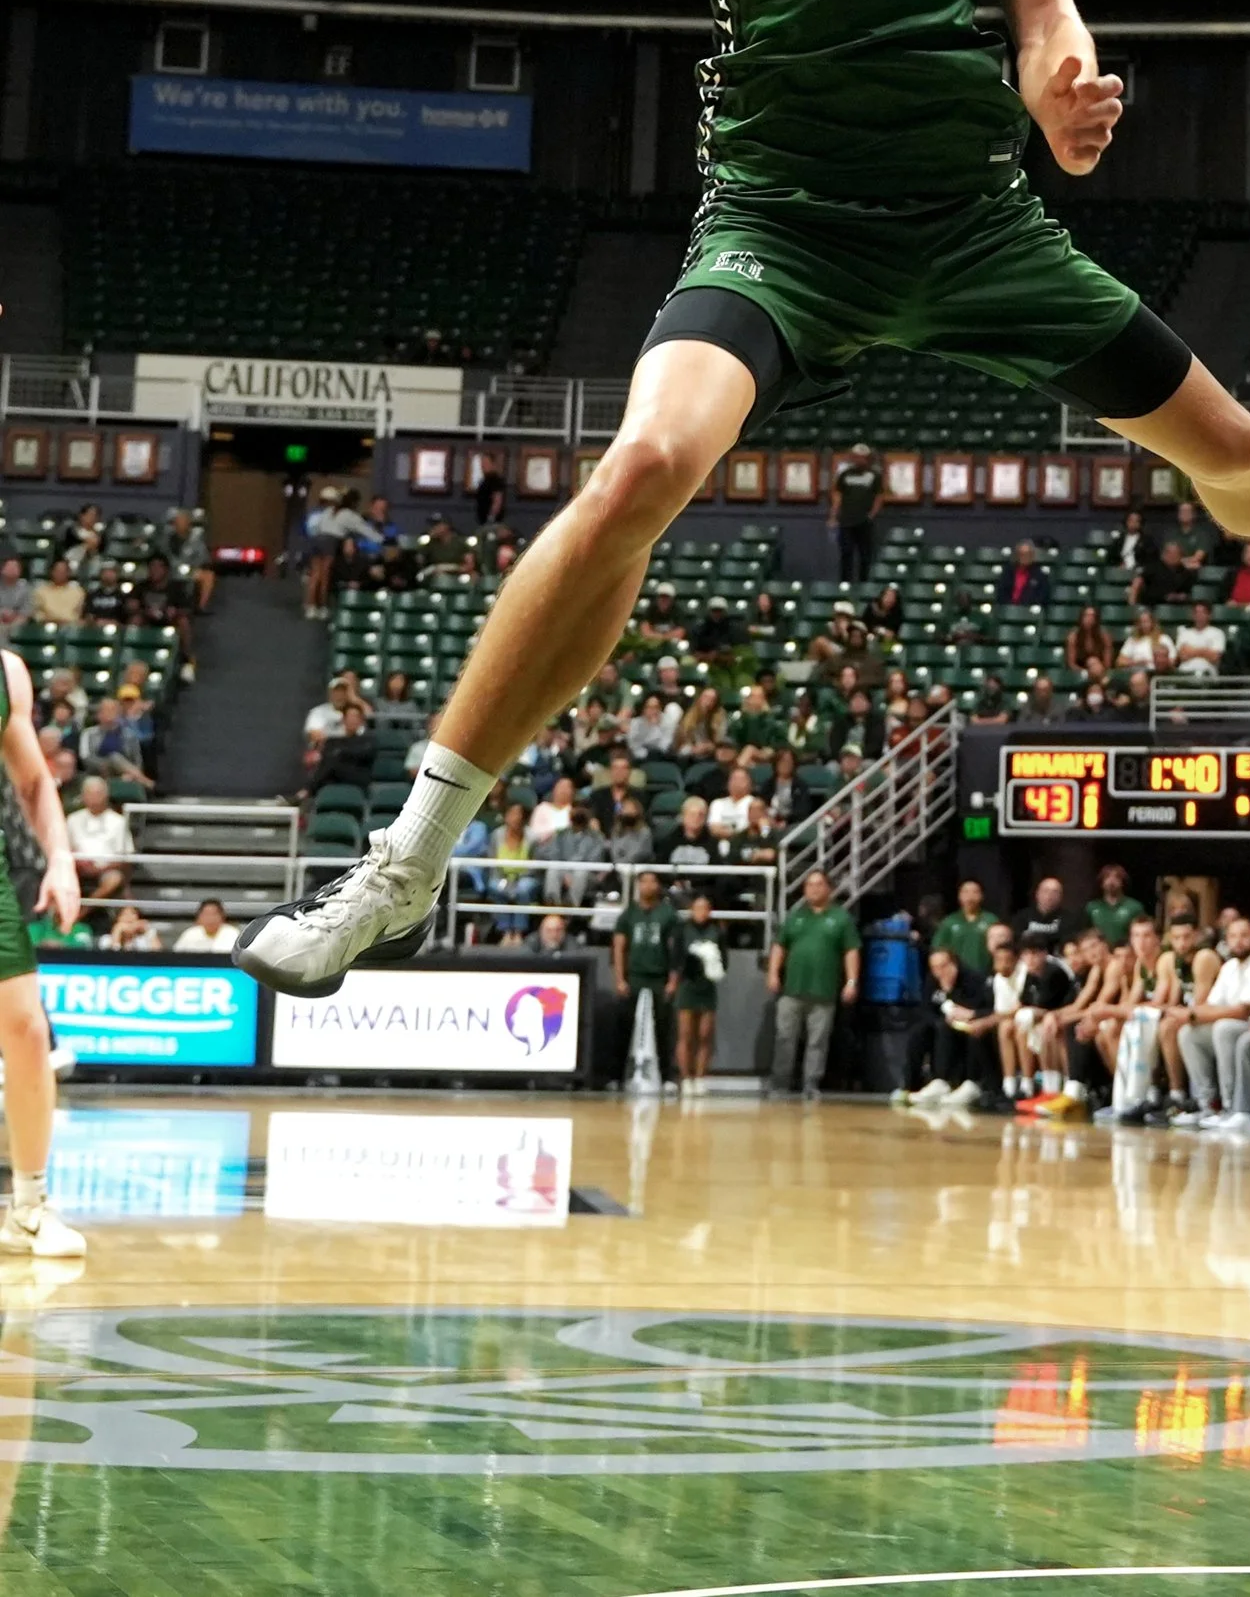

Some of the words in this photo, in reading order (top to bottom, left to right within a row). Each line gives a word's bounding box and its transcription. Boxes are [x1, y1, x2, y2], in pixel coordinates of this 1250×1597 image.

[234, 86, 290, 113] here
[296, 91, 349, 116] with
[204, 359, 392, 402] CALIFORNIA
[1151, 754, 1219, 793] 1:40
[1025, 784, 1070, 823] 43
[1185, 800, 1197, 827] 1
[38, 973, 234, 1016] TRIGGER
[291, 1003, 490, 1033] HAWAIIAN
